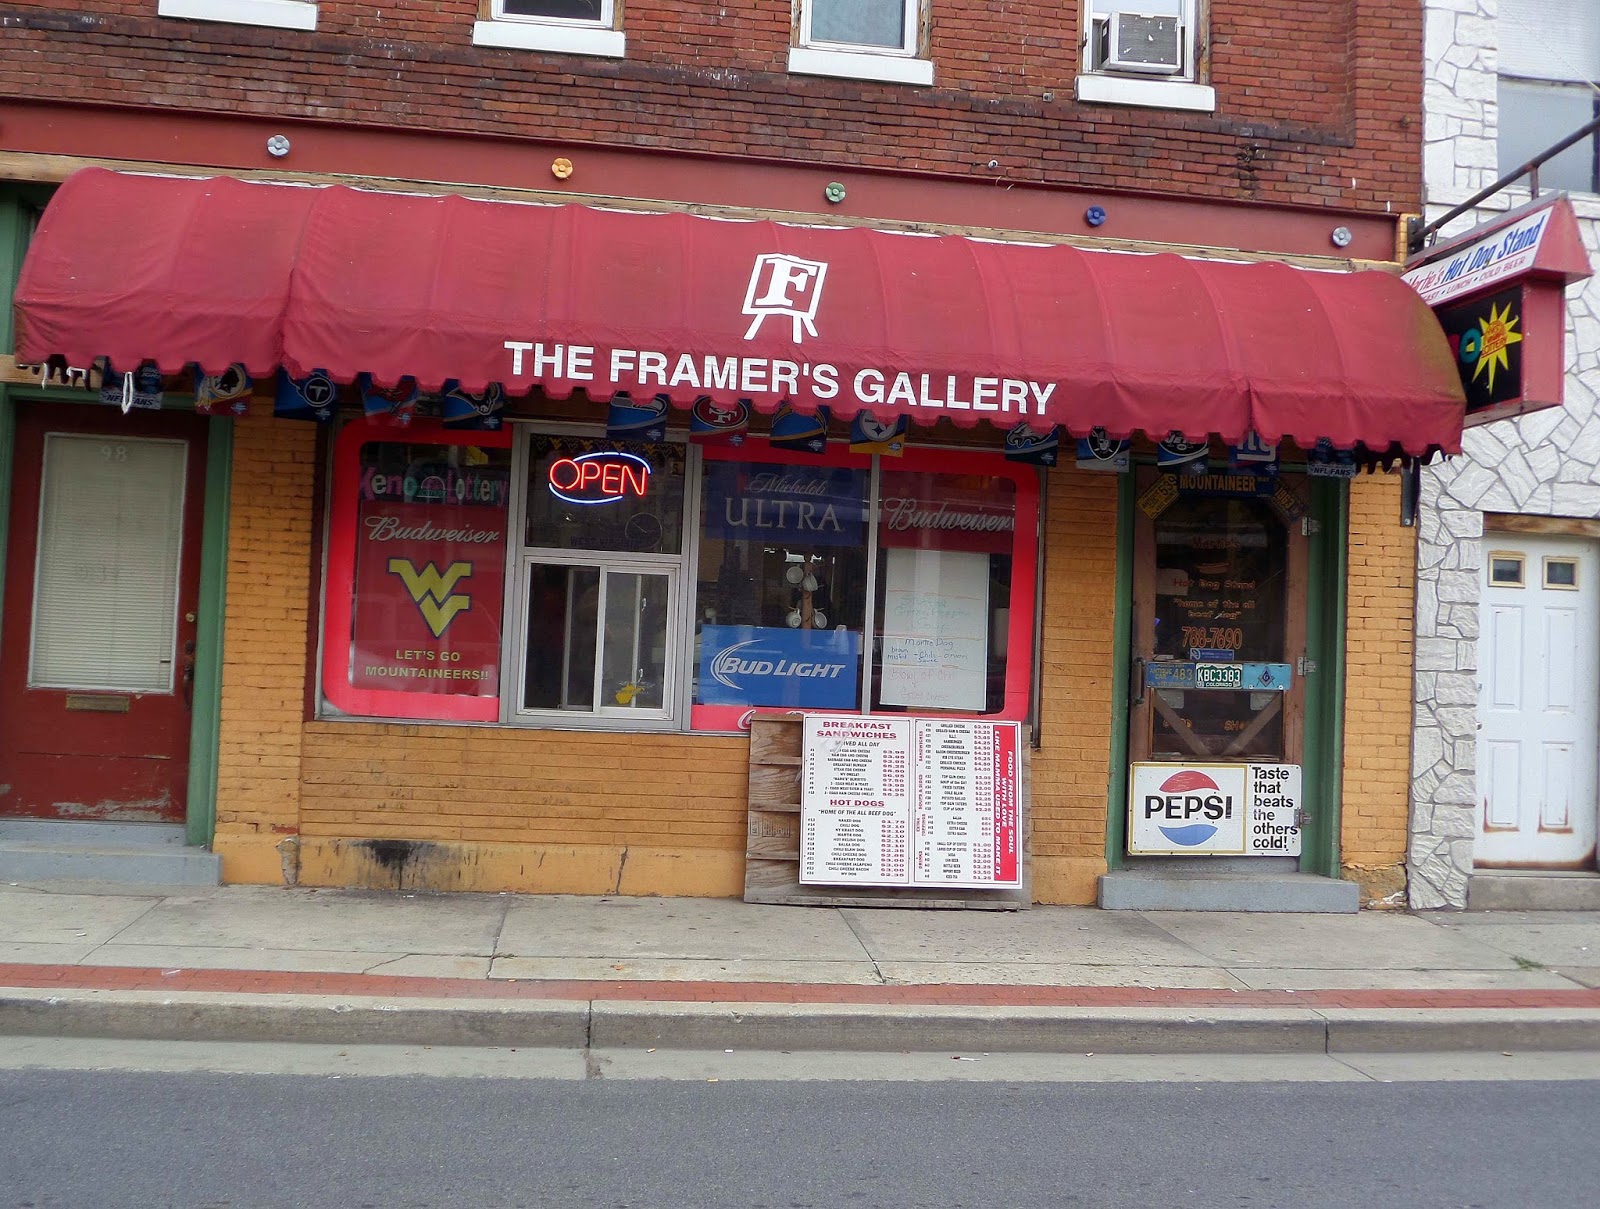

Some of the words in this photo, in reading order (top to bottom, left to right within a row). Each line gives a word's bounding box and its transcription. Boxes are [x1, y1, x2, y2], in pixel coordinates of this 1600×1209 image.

[1441, 252, 1472, 284] Hot
[1467, 243, 1498, 271] Dog
[1498, 214, 1546, 260] Stand
[1446, 277, 1474, 294] LUNCH
[1478, 266, 1502, 282] COLD
[1502, 256, 1526, 271] BEER
[503, 341, 594, 380] THE
[608, 349, 839, 398] FRAMER'S
[853, 369, 1057, 416] GALLERY
[550, 459, 646, 496] OPEN
[1180, 474, 1256, 492] MOUNTAINEER
[724, 498, 842, 532] ULTRA
[884, 498, 1014, 531] Budweiser
[364, 516, 500, 544] Budweiser
[935, 637, 954, 650] Dog
[1181, 626, 1243, 650] 788-7690
[396, 650, 435, 660] LET'S
[440, 650, 460, 662] GO
[365, 666, 489, 680] MOUNTAINEERS!!
[720, 657, 774, 675] BUD
[774, 660, 846, 678] LIGHT
[822, 721, 892, 730] BREAKFAST
[816, 730, 897, 739] SANDWICHES
[1252, 766, 1290, 780] Taste
[1253, 780, 1282, 794] that
[1144, 795, 1233, 820] PEPSI
[1254, 796, 1294, 808] beats
[1253, 809, 1276, 821] the
[995, 822, 1000, 834] TO
[1253, 822, 1298, 835] others
[1253, 836, 1288, 849] cold!
[995, 866, 1001, 875] IT
